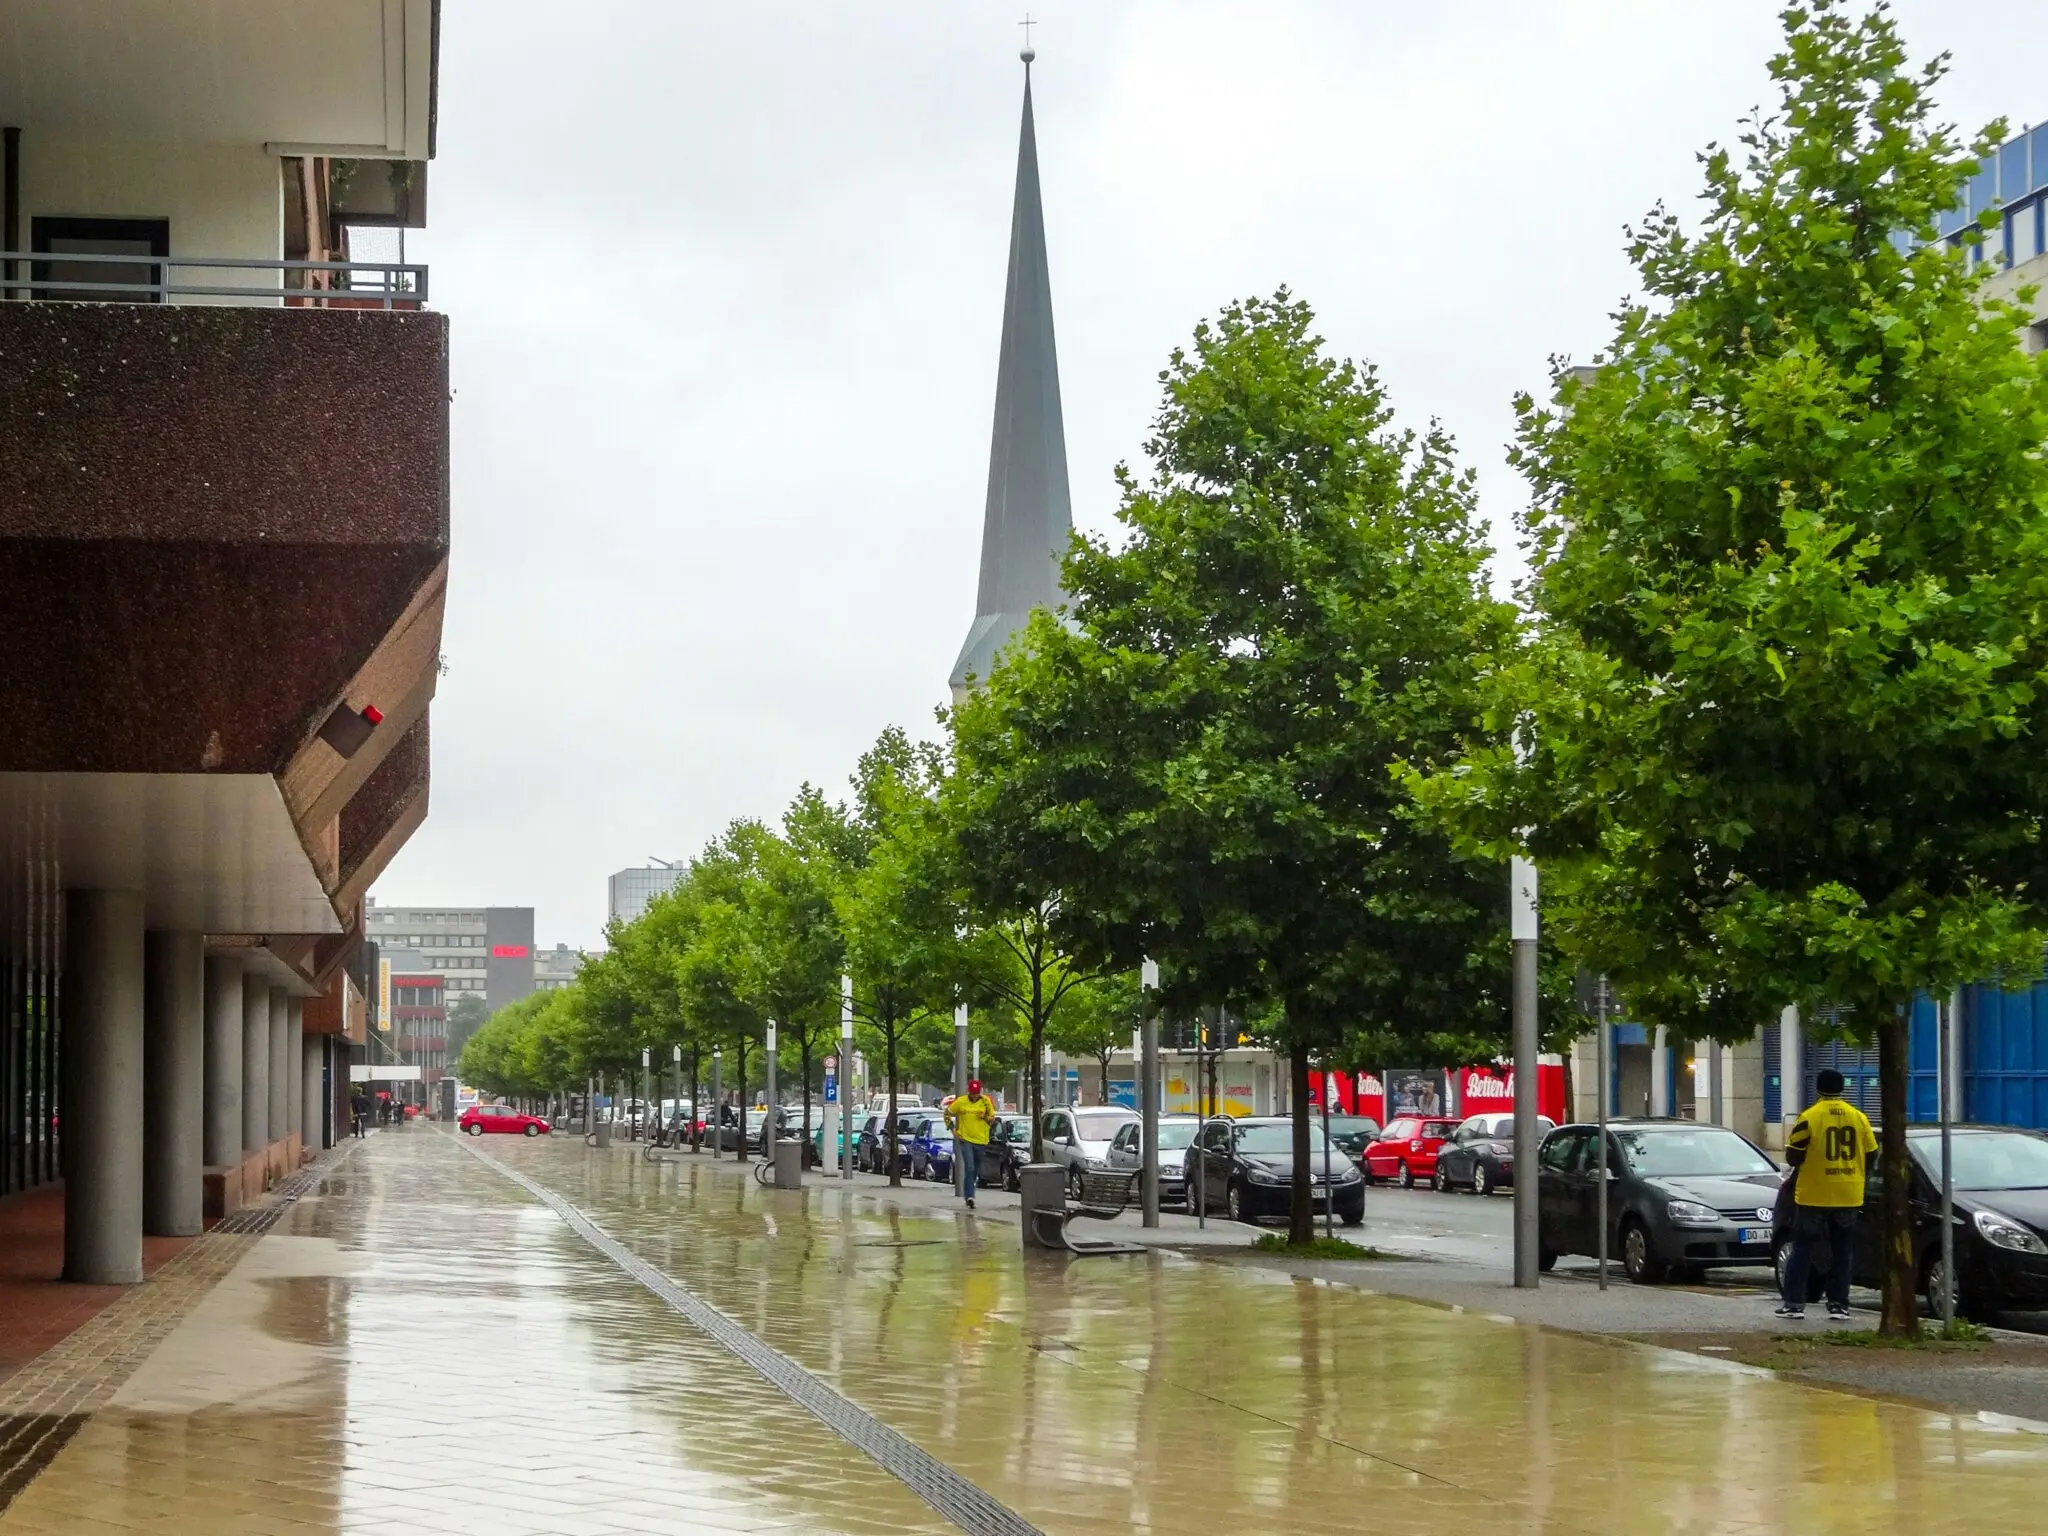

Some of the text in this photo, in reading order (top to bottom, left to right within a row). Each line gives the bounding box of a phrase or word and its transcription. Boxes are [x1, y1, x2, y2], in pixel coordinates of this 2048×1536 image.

[828, 1089, 835, 1097] P
[1466, 1072, 1505, 1098] Betten
[1826, 1126, 1856, 1161] 09
